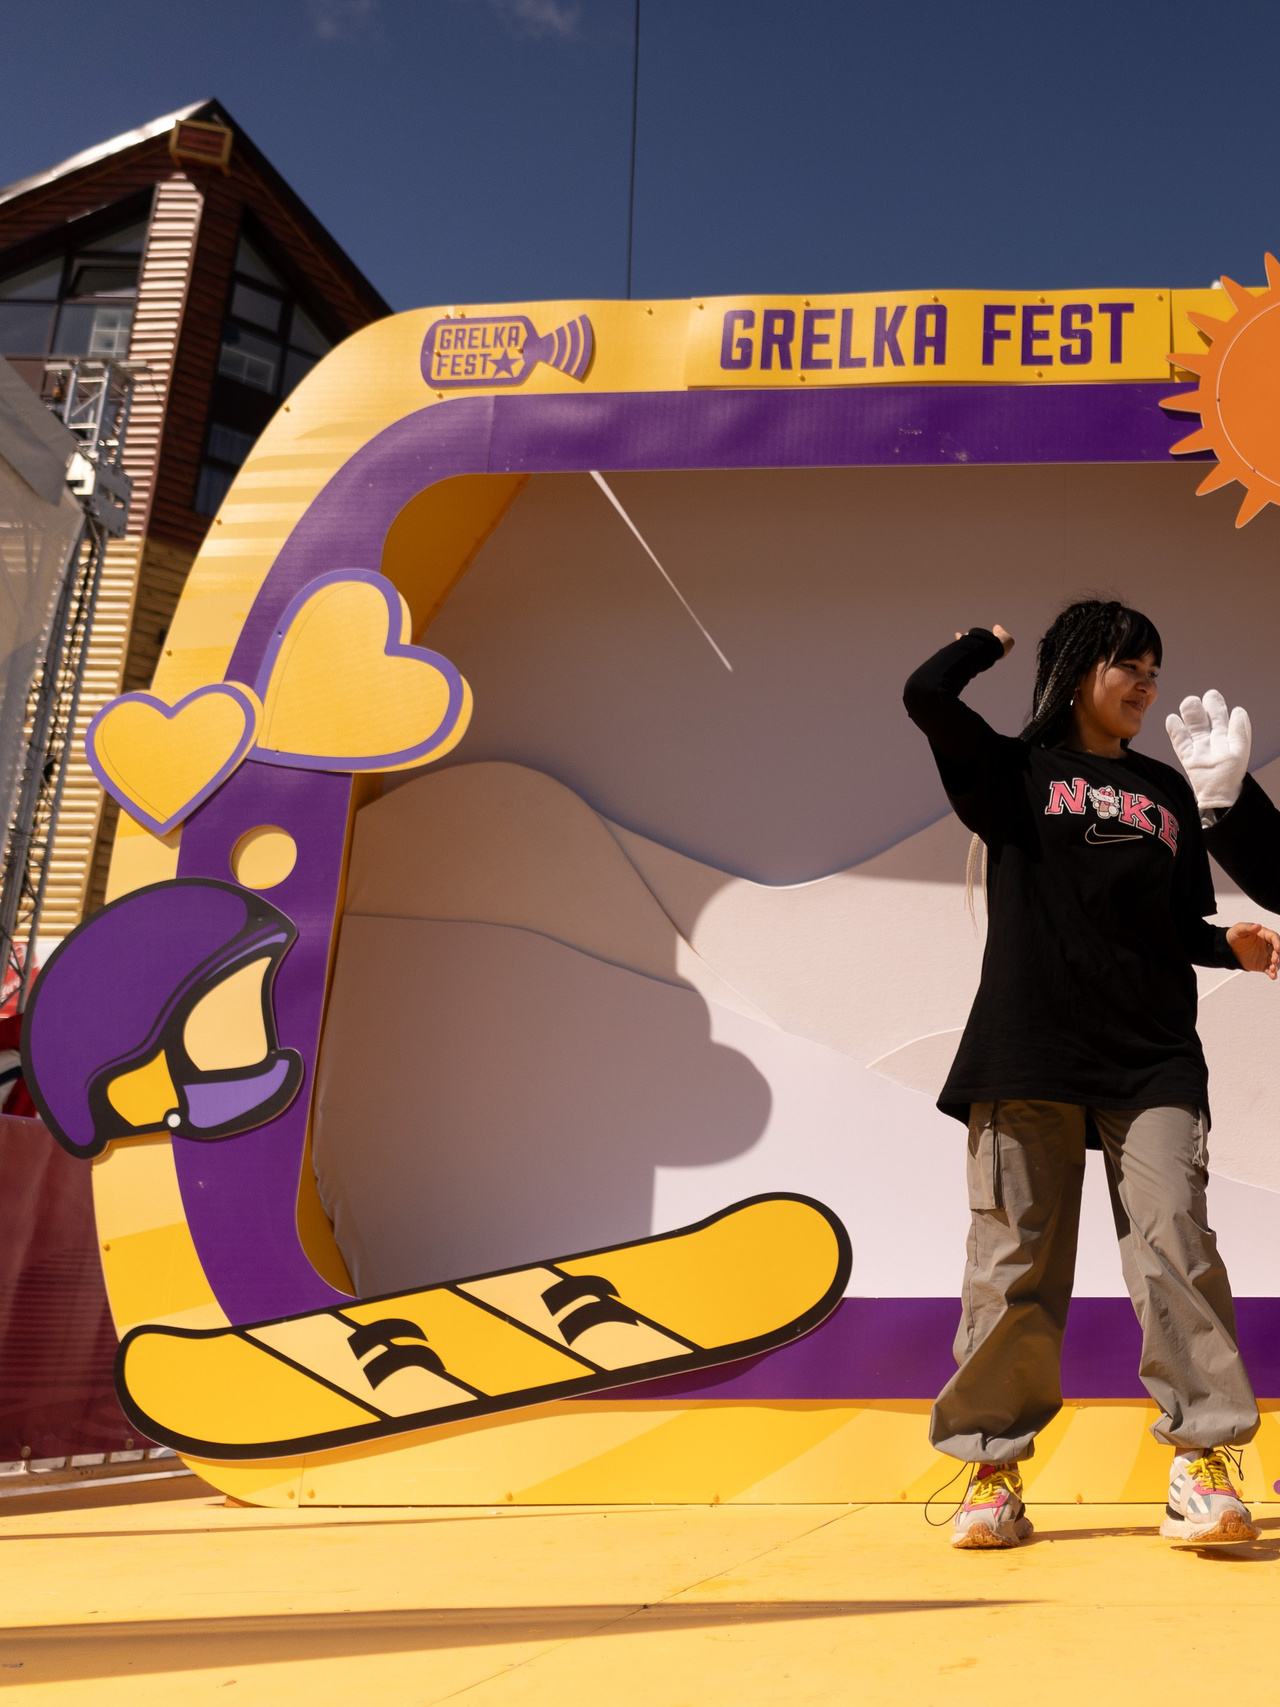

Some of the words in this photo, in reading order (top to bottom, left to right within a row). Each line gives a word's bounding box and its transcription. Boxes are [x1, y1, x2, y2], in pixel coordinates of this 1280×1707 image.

[439, 325, 520, 350] GRELKA
[720, 303, 948, 371] GRELKA
[982, 302, 1135, 367] FEST
[436, 353, 492, 377] FEST
